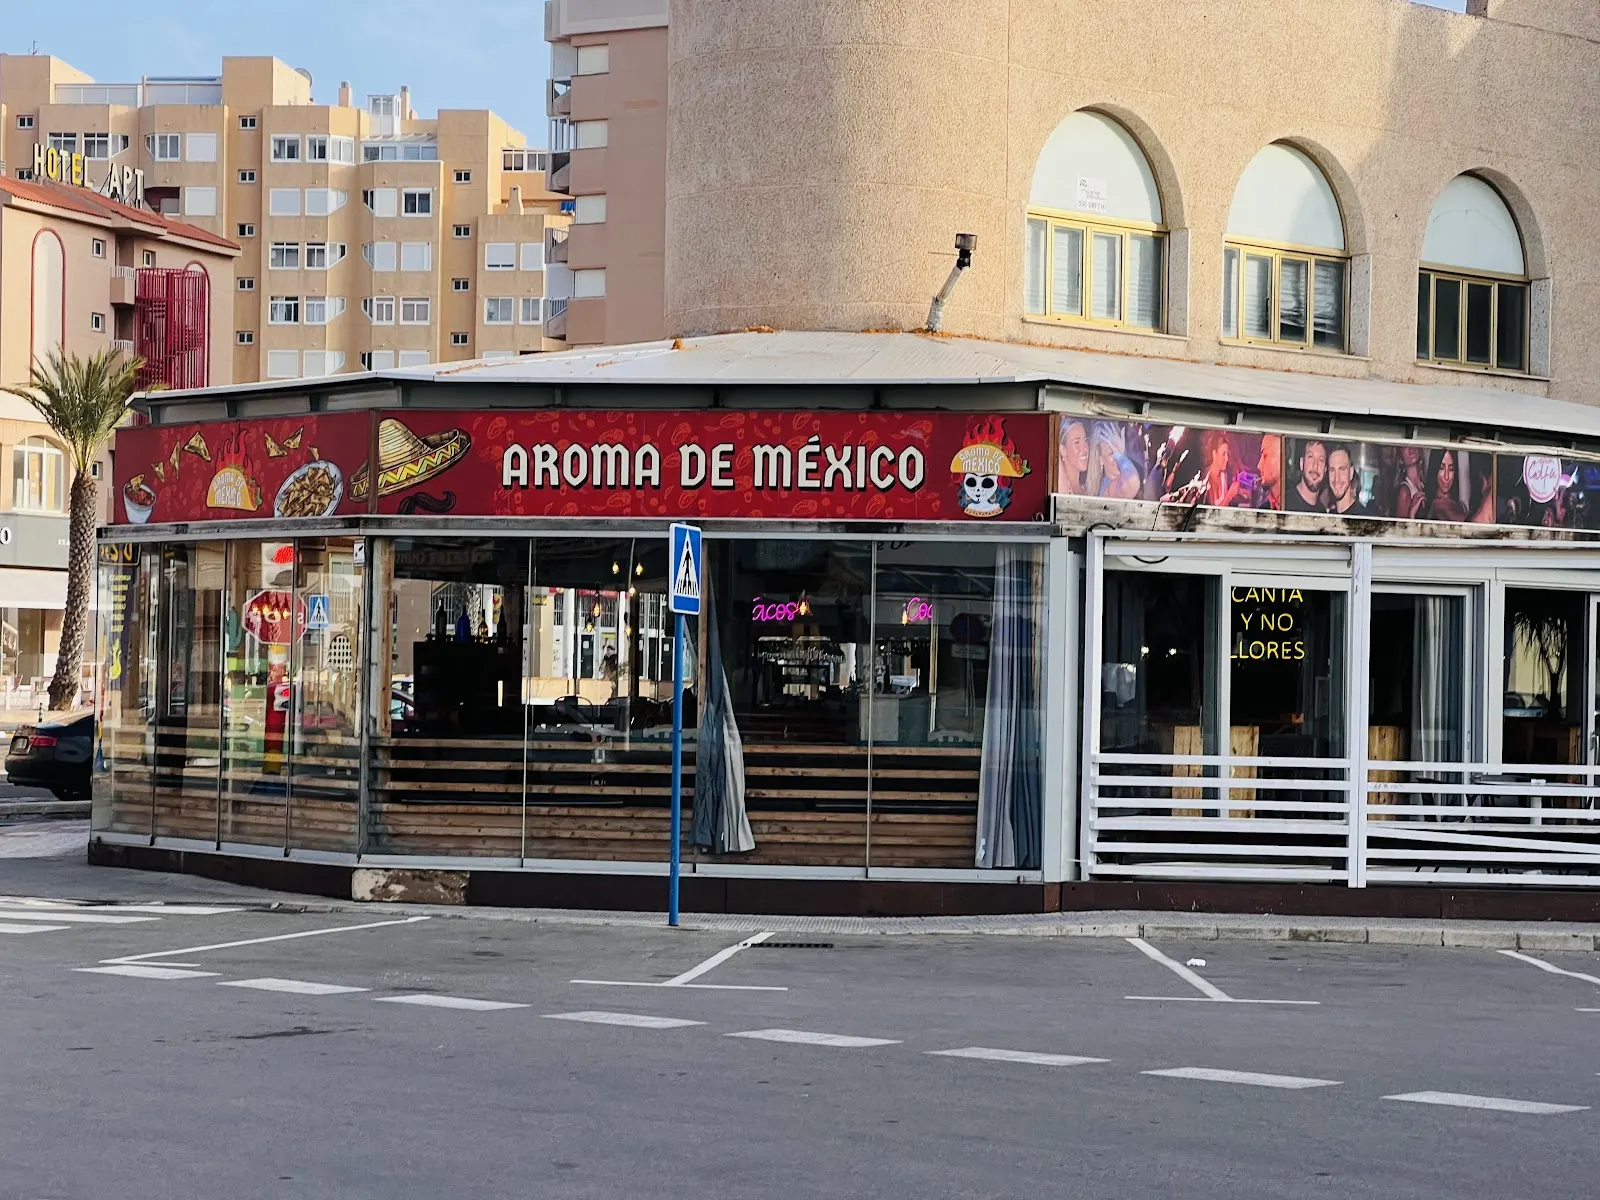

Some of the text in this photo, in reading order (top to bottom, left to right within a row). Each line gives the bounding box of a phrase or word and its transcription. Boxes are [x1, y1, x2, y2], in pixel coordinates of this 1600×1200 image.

[33, 142, 145, 203] HOTEL APT
[502, 434, 925, 491] AROMA DE MÉXICO
[958, 447, 1005, 462] AROMA DE
[0, 526, 12, 545] O
[752, 596, 799, 622] acos
[1240, 612, 1294, 632] Y NO
